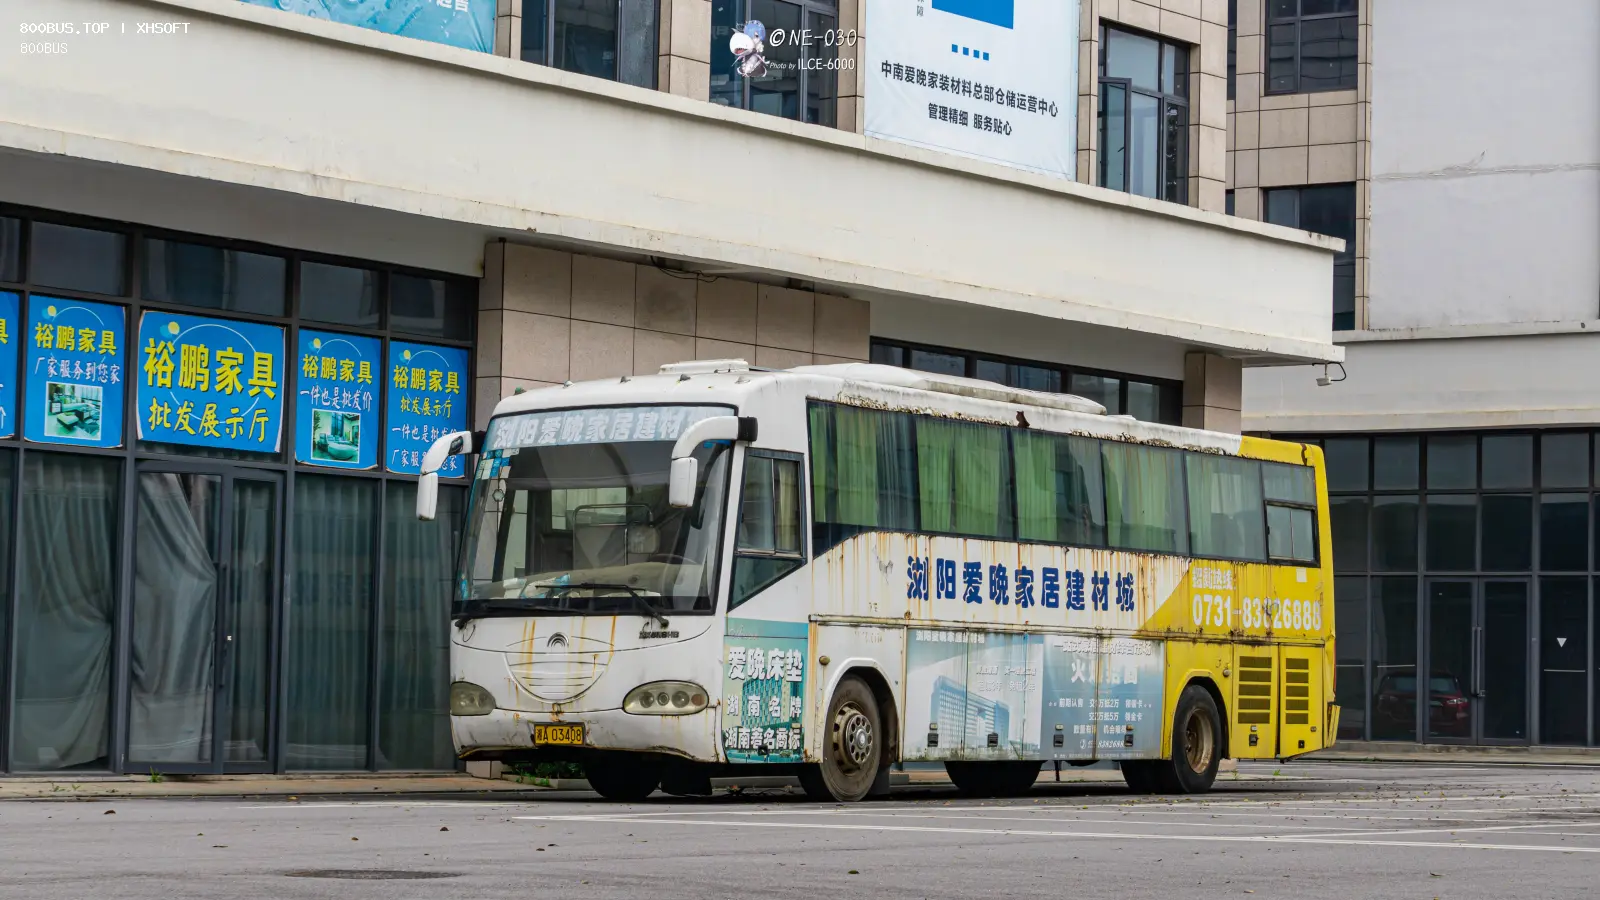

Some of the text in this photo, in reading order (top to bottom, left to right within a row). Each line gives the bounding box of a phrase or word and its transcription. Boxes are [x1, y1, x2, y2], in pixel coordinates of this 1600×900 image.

[881, 60, 1058, 118] 中南爱晚家装材料总部仓储运营中心
[928, 102, 1013, 136] 管理精细 服务贴心
[35, 321, 117, 356] 裕鹏家具
[35, 356, 120, 385] 厂家服务到您家
[144, 337, 278, 399] 裕鹏家具
[303, 354, 373, 384] 裕鹏家具
[393, 364, 460, 394] 裕鹏家具
[300, 385, 373, 412] 一件也是批发价
[400, 396, 452, 418] 批发展示厅
[148, 397, 270, 443] 批发展示厅
[907, 556, 1135, 612] 浏阳爱晚家居建材城
[728, 646, 803, 682] 爱晚床垫
[727, 694, 802, 718] 湖南名牌
[725, 726, 801, 750] 湖南著名商标
